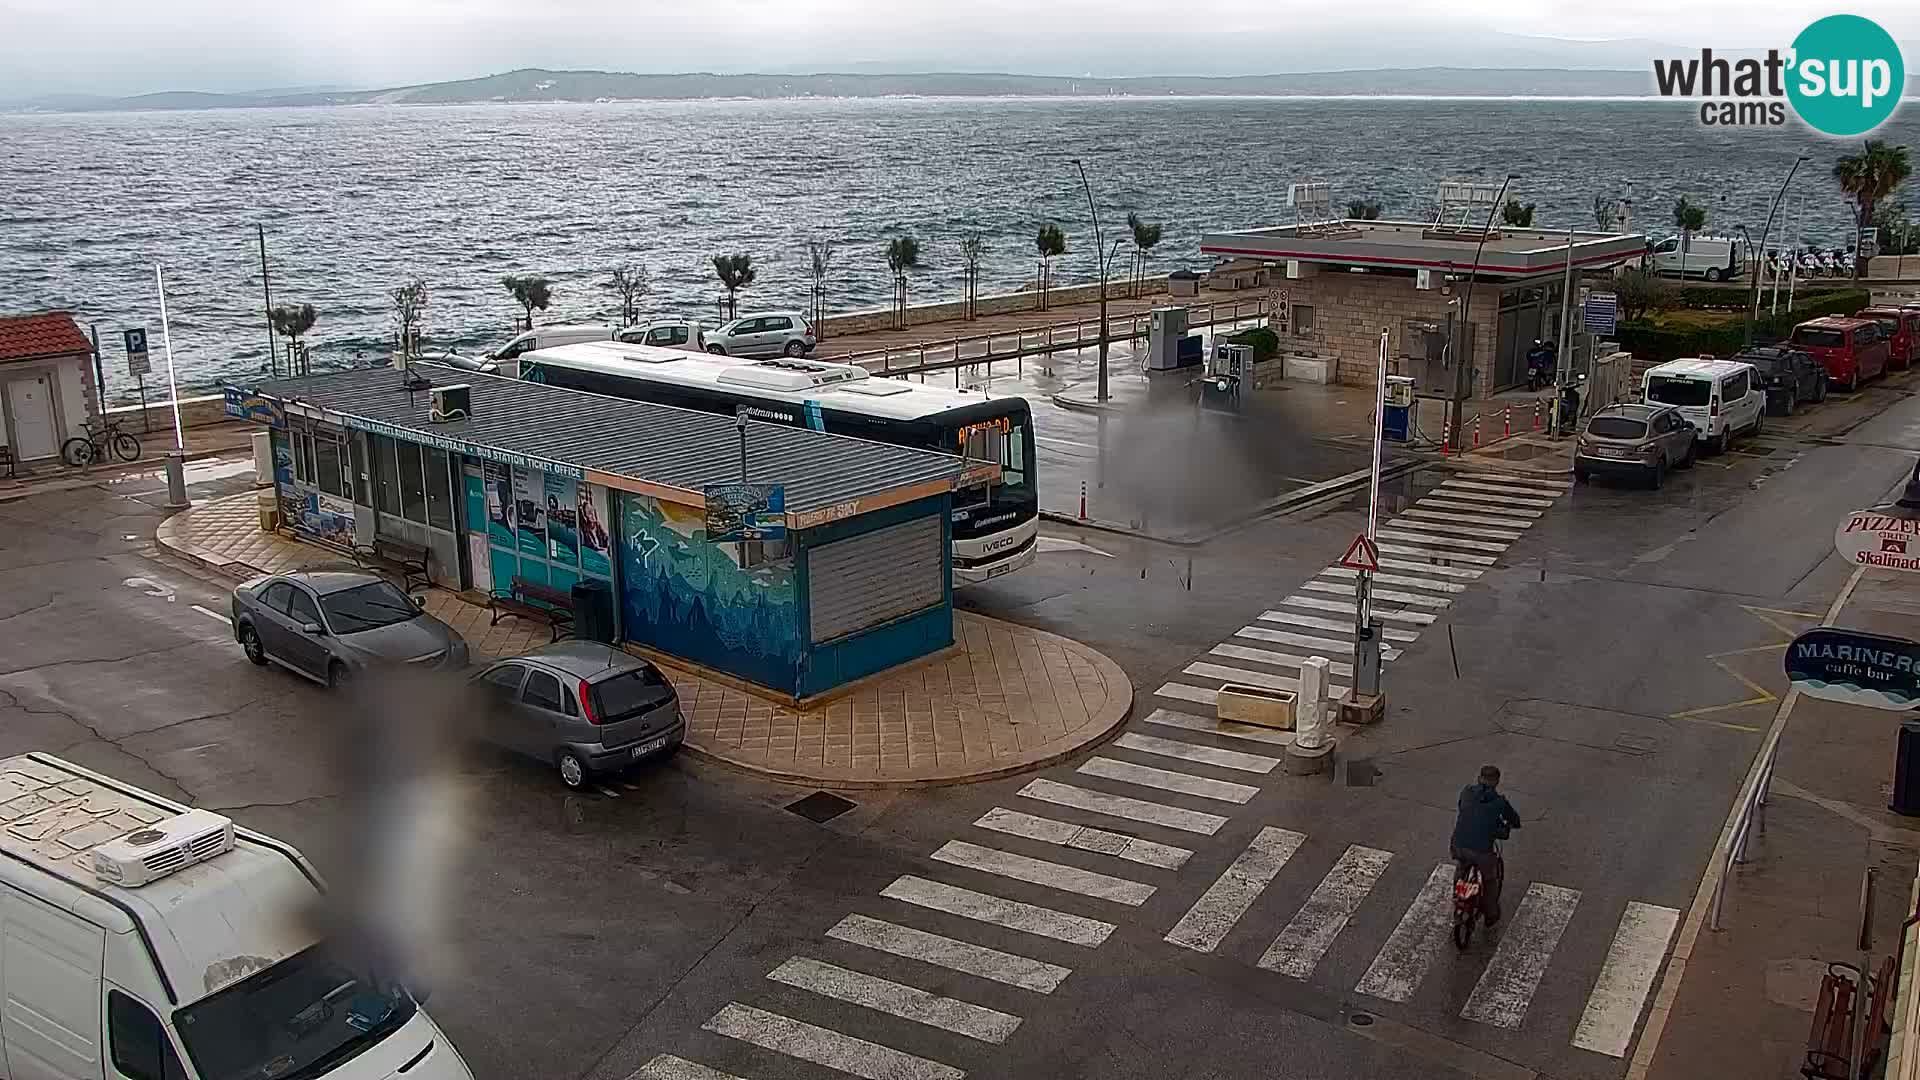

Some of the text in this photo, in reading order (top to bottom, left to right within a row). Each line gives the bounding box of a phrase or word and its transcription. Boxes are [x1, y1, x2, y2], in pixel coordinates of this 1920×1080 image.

[130, 332, 142, 350] P
[435, 437, 466, 452] POSTAJA
[477, 447, 491, 459] BUS
[492, 449, 525, 466] STATION
[527, 458, 553, 473] TICKET
[554, 463, 581, 478] OFFICE
[983, 537, 1013, 552] IVECO
[1825, 663, 1894, 680] caffe bar
